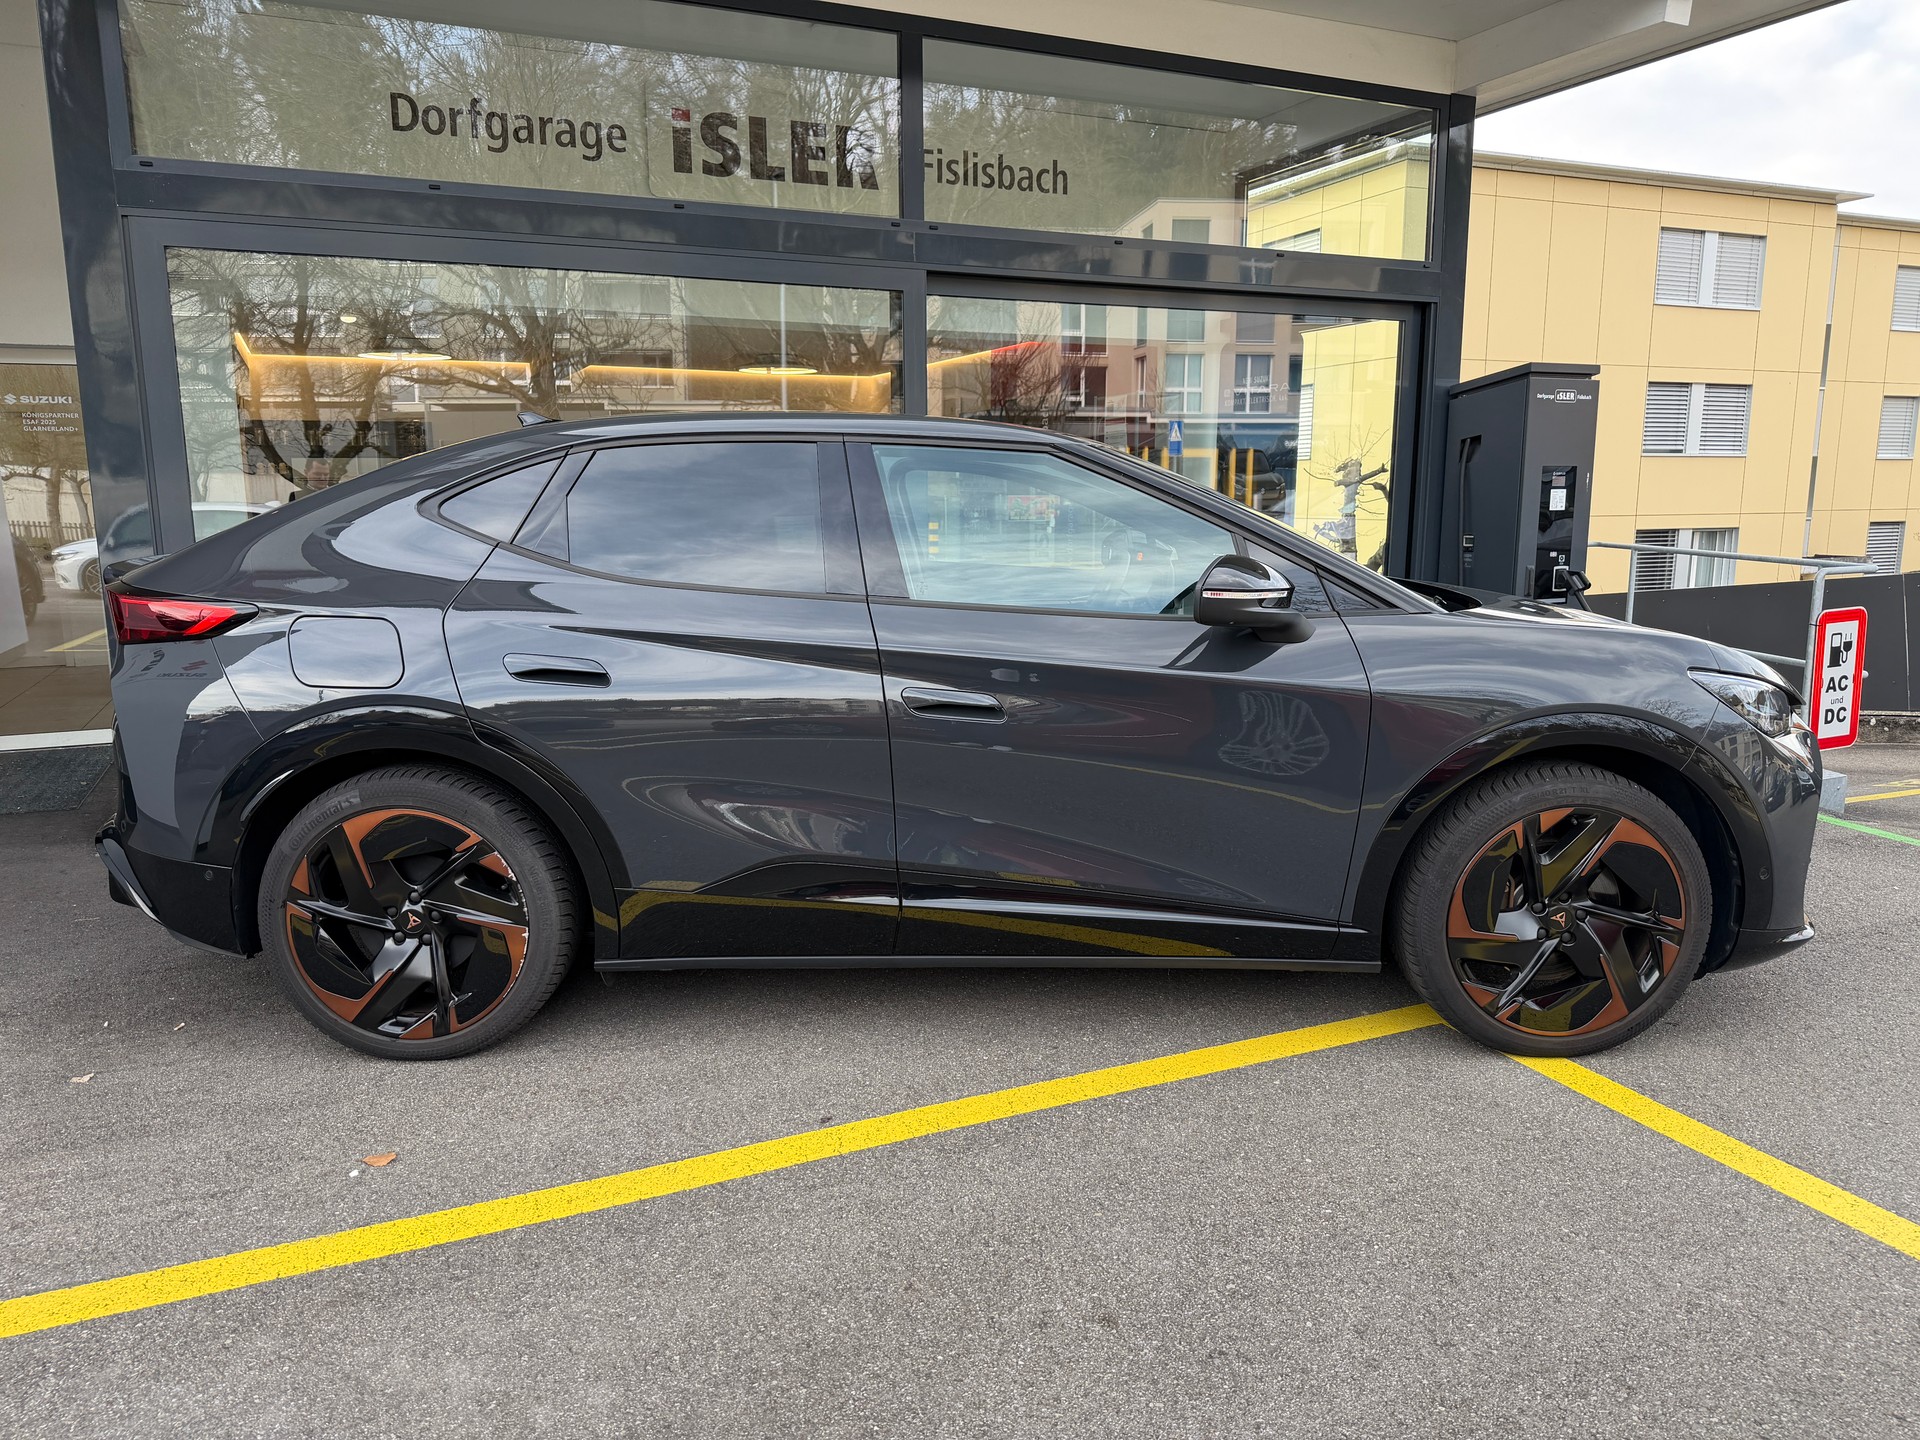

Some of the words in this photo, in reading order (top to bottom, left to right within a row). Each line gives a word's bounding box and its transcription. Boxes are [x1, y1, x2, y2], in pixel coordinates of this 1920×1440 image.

[389, 91, 627, 162] Dorfgarage
[20, 395, 72, 404] SUZUKI
[22, 411, 80, 419] KÖNIGSPARTNER
[1825, 674, 1849, 694] AC
[1830, 696, 1844, 705] und
[1824, 706, 1847, 725] DC
[288, 800, 345, 851] Continental
